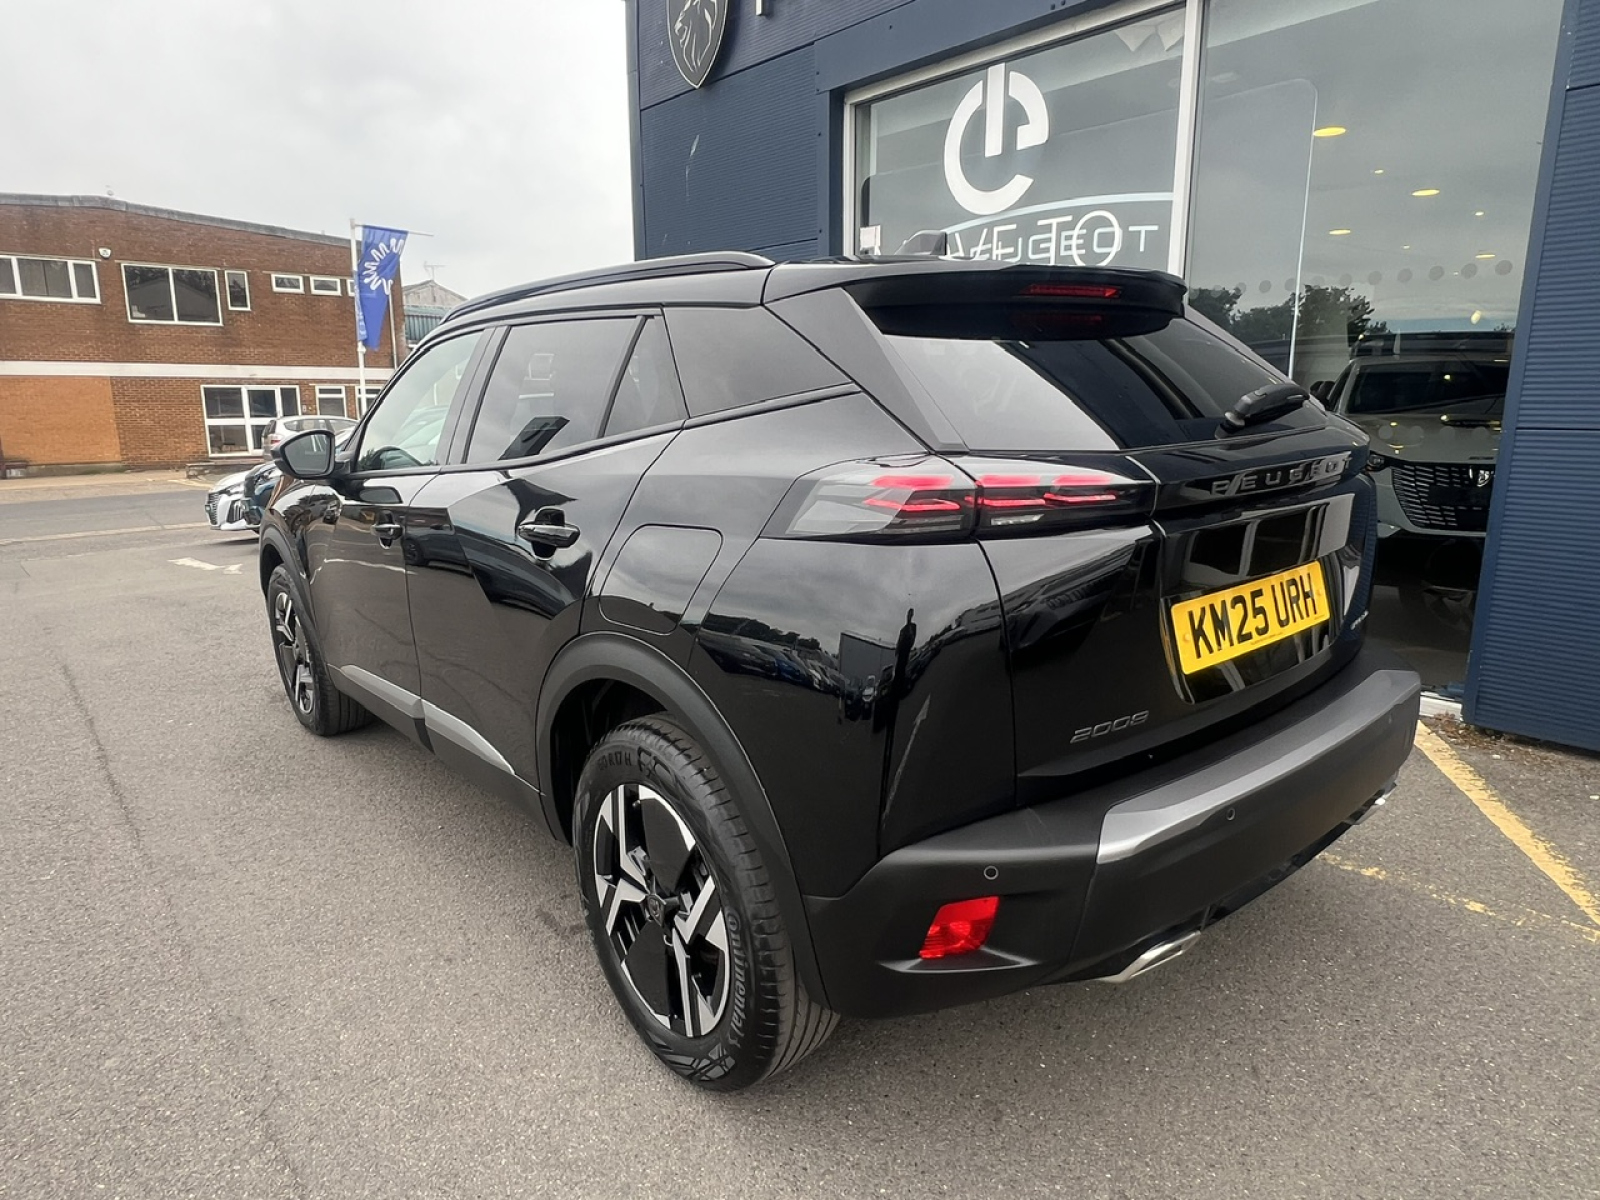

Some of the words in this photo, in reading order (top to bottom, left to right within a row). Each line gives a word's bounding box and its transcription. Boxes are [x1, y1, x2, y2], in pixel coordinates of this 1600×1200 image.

[948, 225, 1159, 264] EUGEOT
[1210, 457, 1353, 496] PEUGEOT
[1187, 587, 1270, 660] KM25
[1270, 572, 1317, 629] URH
[1069, 710, 1149, 744] 2008
[724, 905, 746, 1037] Continental
